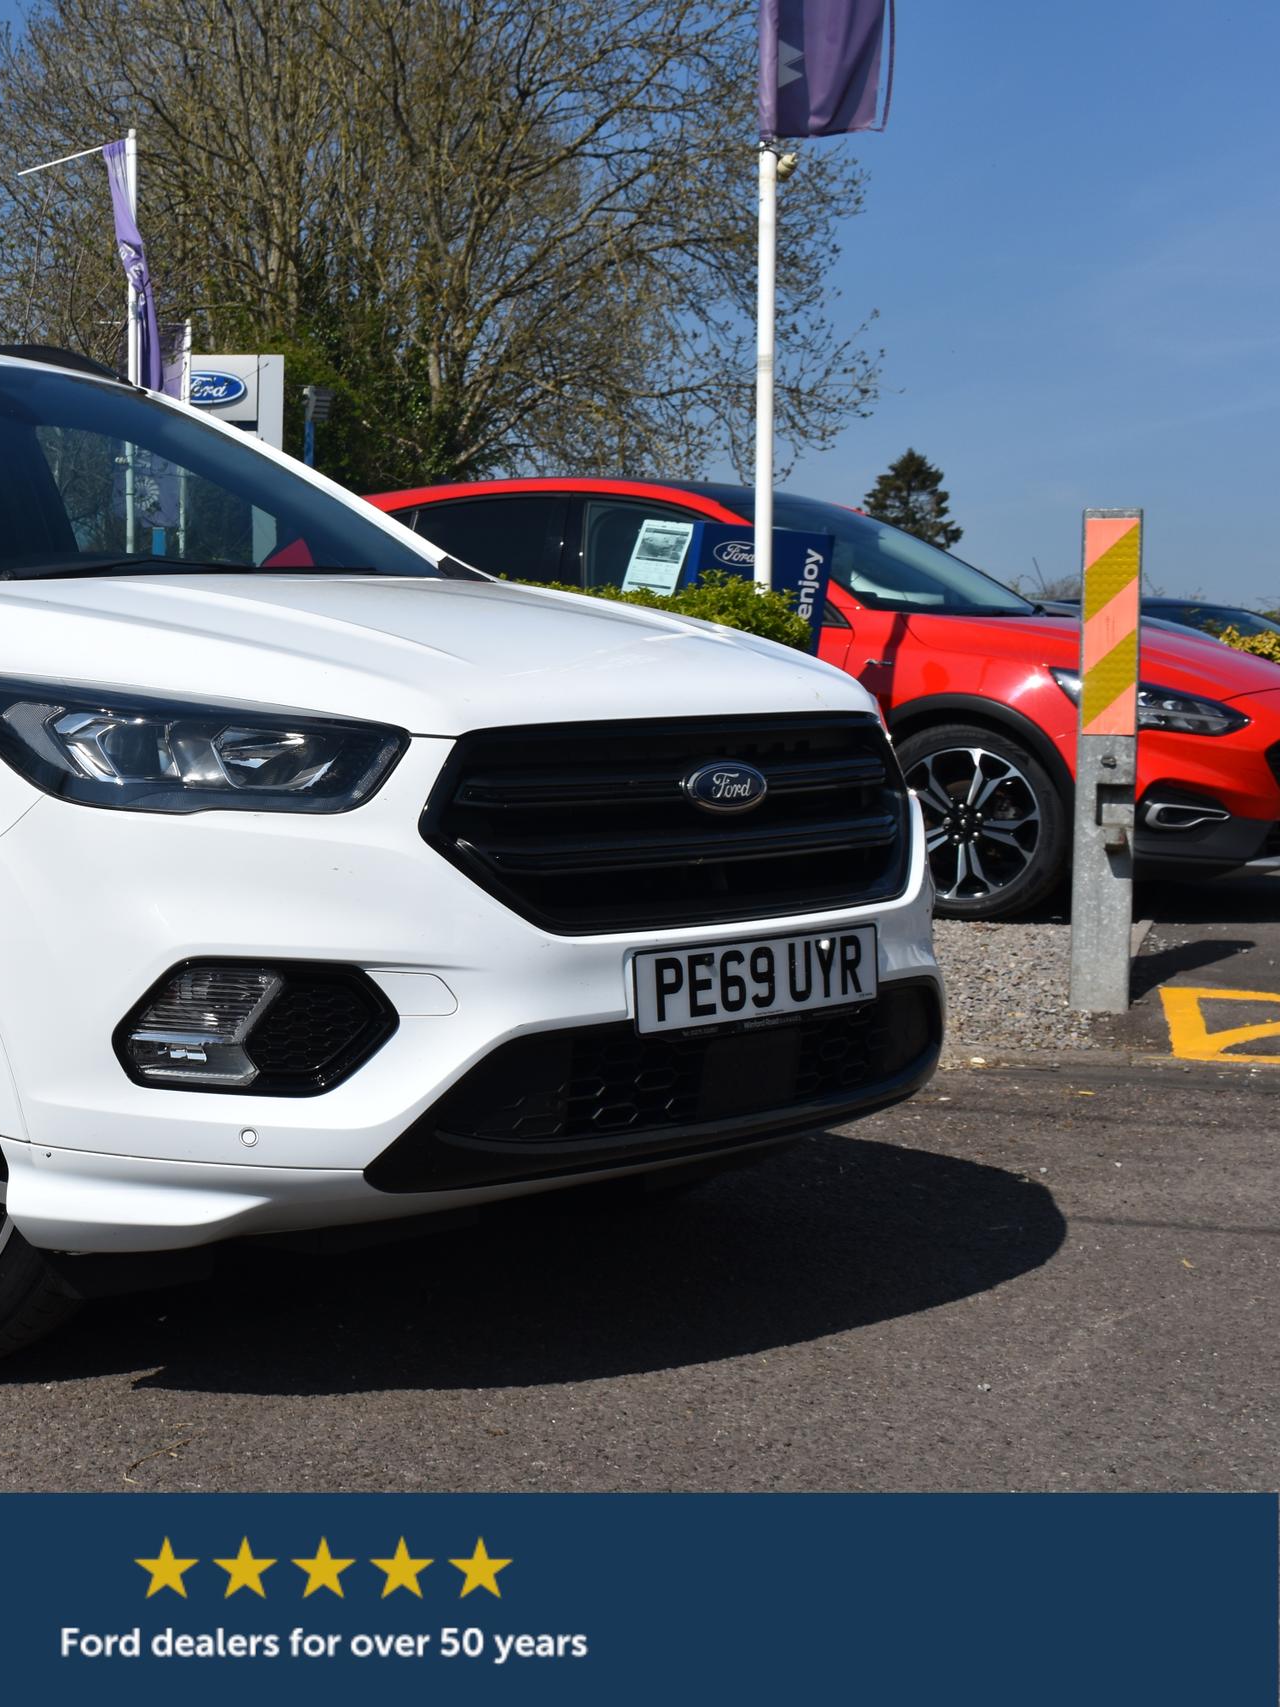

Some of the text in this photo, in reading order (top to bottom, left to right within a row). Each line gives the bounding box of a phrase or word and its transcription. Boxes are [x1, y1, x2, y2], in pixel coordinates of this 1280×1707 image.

[190, 376, 229, 397] Ford
[797, 548, 824, 620] enjoy
[712, 772, 751, 798] Ford
[655, 935, 862, 1022] PE69 UYR
